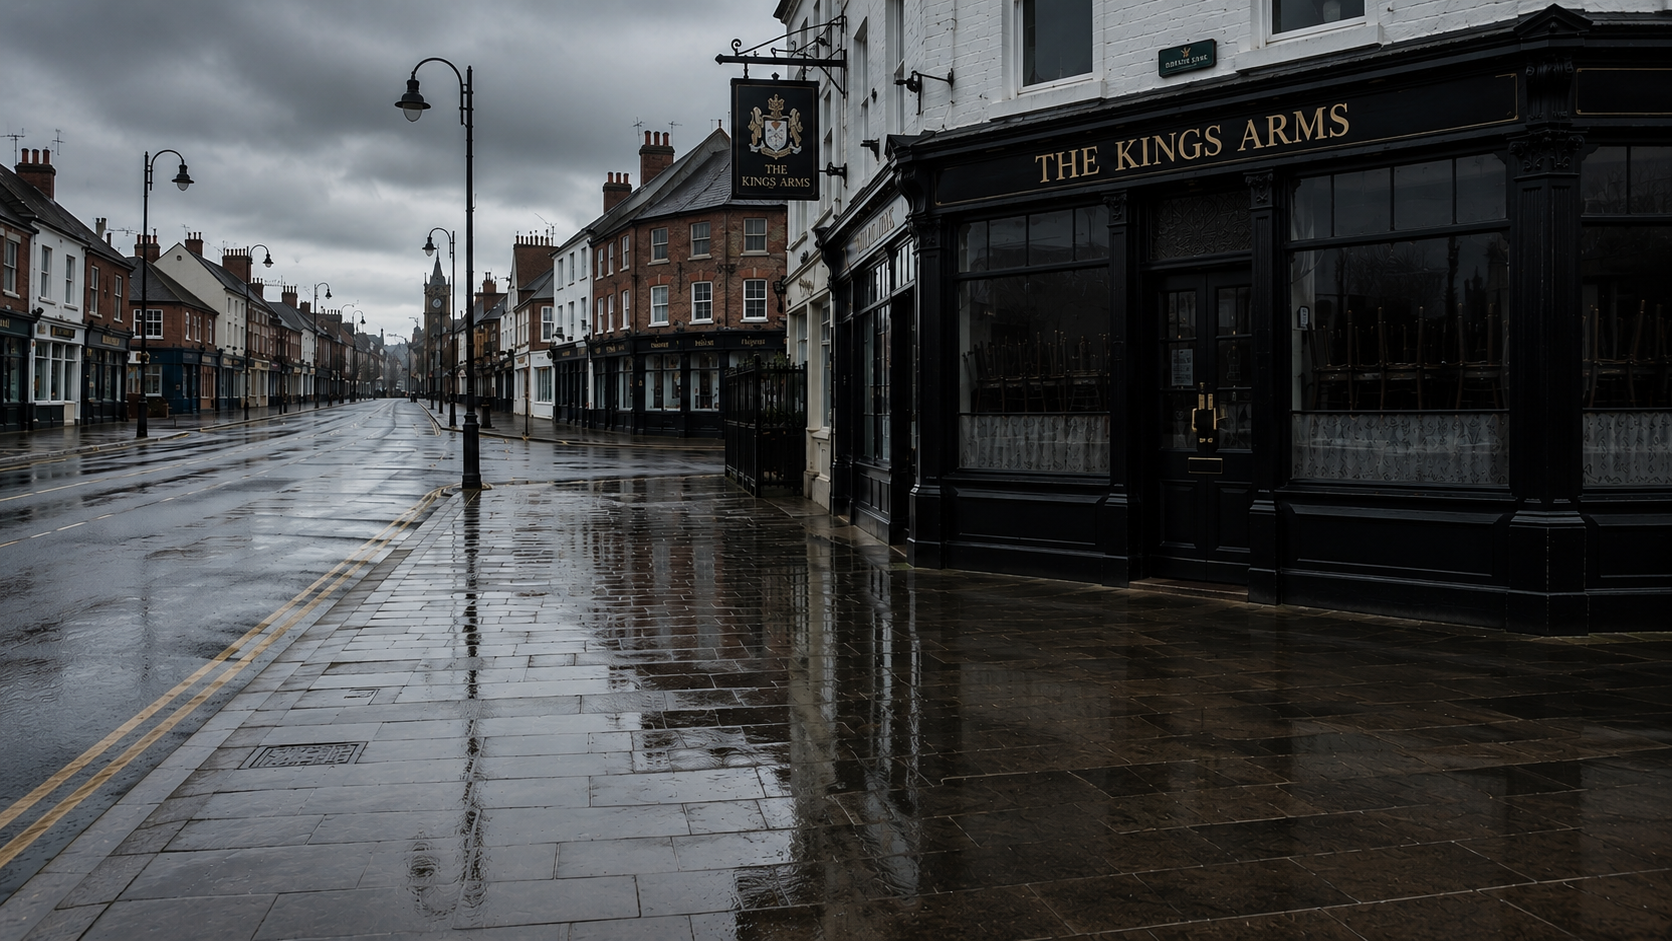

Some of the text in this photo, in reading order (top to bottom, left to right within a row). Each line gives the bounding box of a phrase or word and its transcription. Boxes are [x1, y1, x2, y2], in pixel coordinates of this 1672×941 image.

[1034, 102, 1351, 184] THE KINGS ARMS
[765, 164, 788, 175] THE
[741, 176, 811, 188] KINGS ARMS
